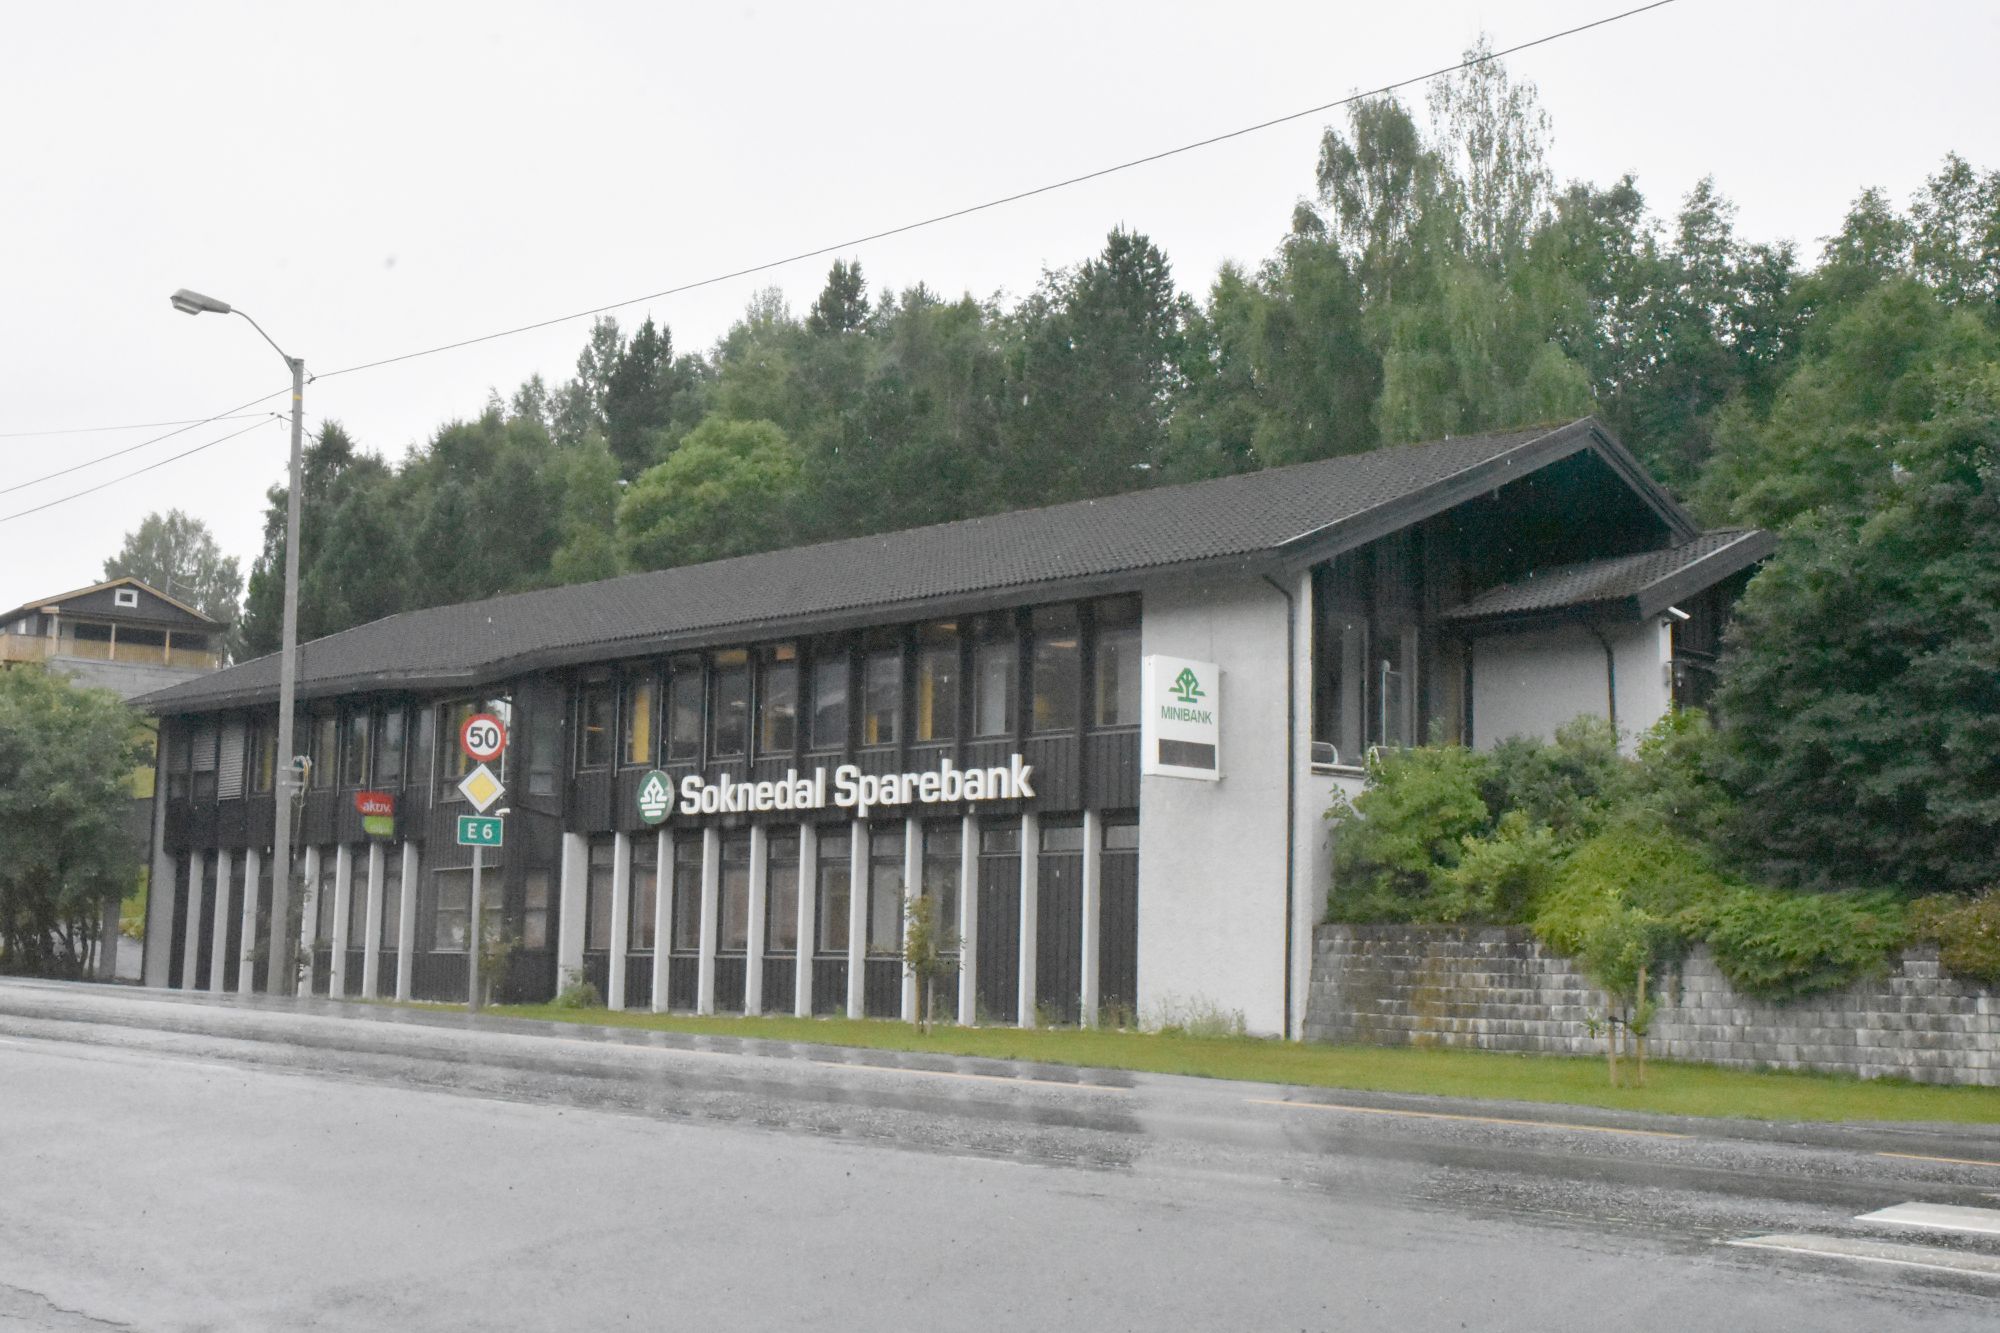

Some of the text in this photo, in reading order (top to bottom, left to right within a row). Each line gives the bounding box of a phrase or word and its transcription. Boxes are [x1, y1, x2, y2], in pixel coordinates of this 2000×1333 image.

[1161, 706, 1212, 724] MINIBANK
[469, 727, 498, 748] 50
[680, 753, 1035, 817] Soknedal Sparebank
